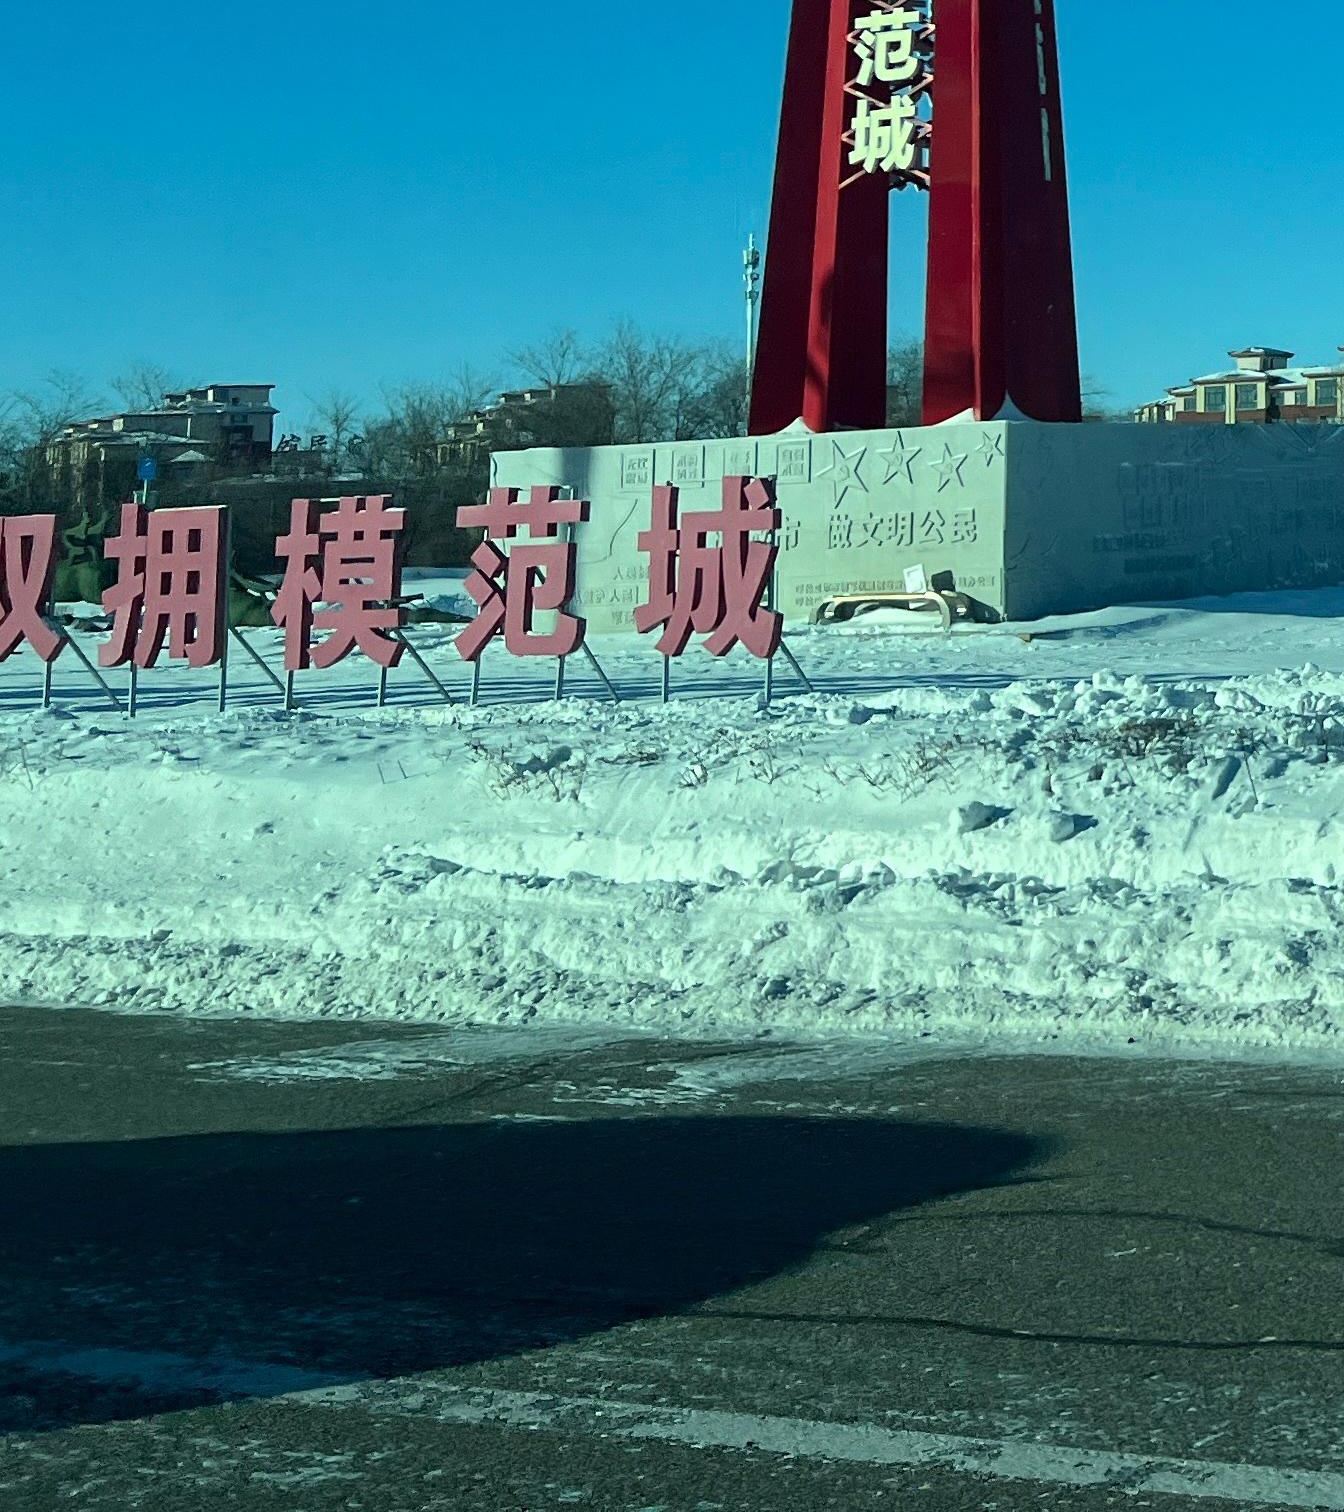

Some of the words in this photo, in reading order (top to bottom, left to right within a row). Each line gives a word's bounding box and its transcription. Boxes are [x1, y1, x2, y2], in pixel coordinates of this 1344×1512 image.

[827, 508, 978, 549] 做文明公民
